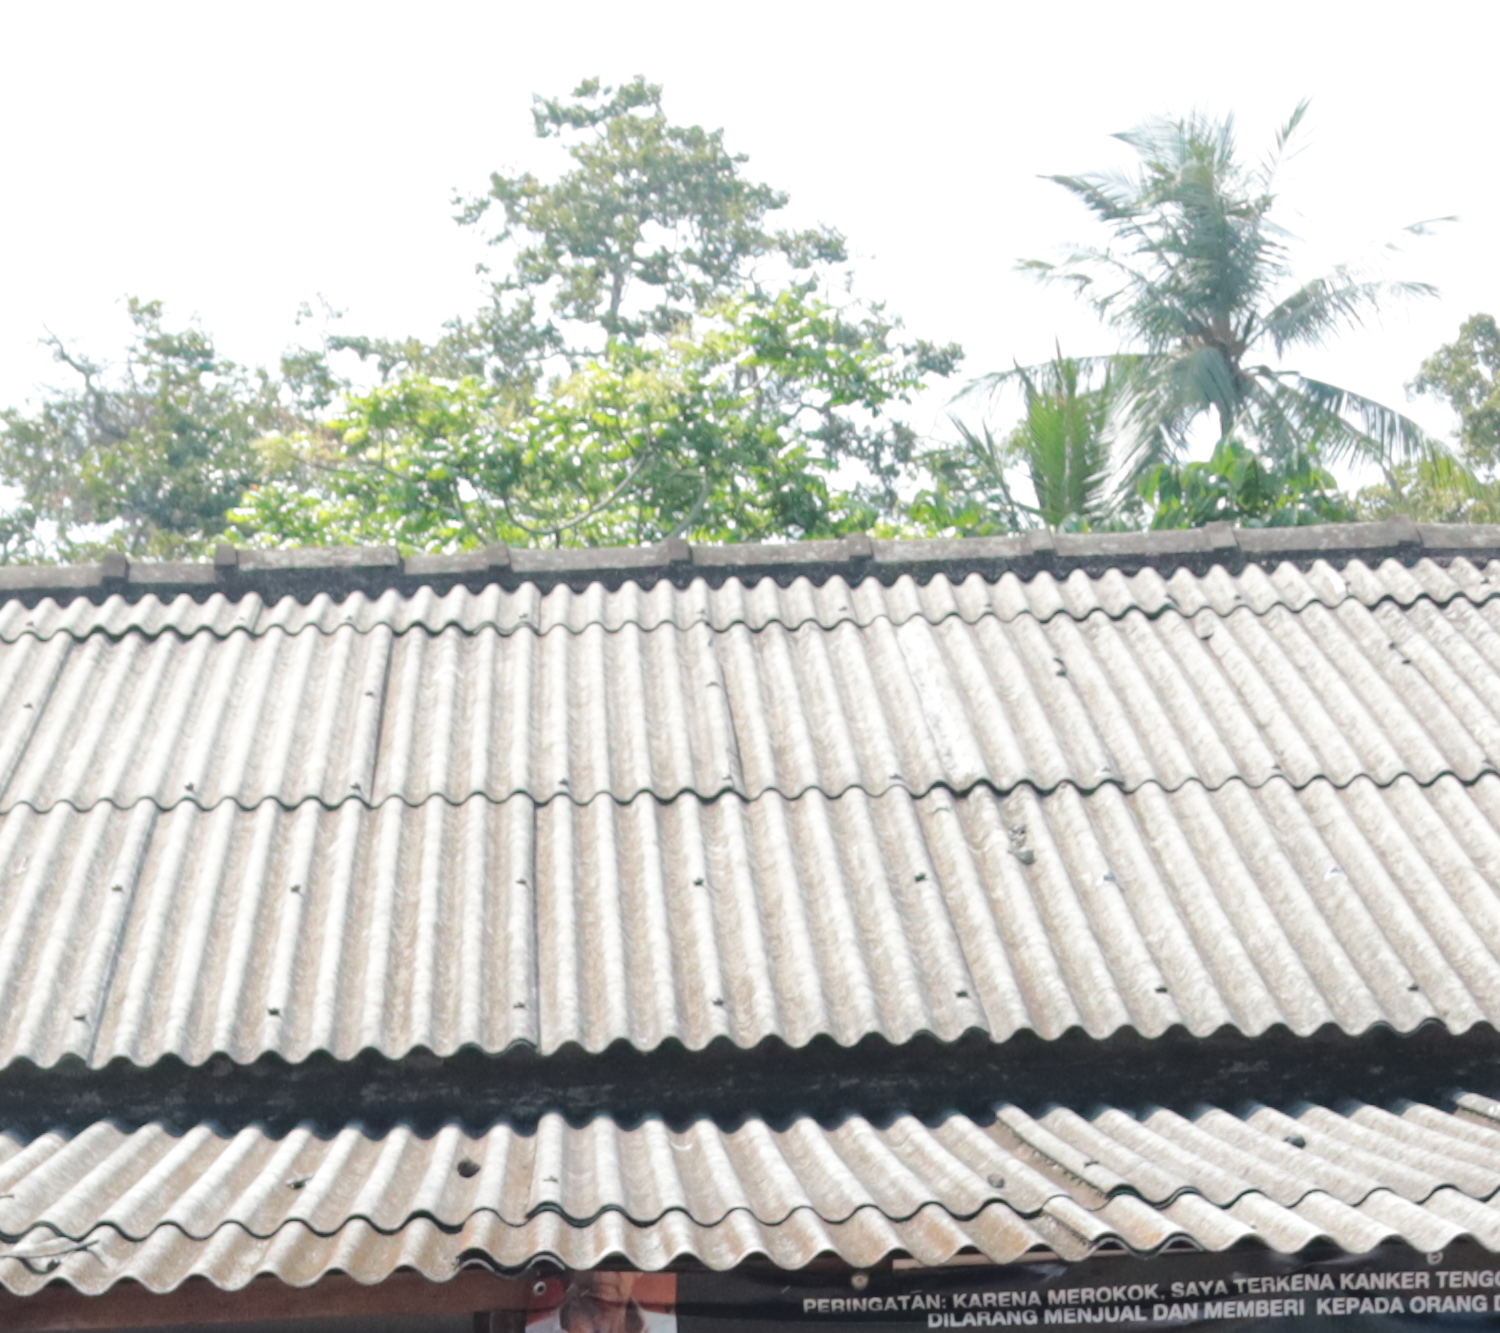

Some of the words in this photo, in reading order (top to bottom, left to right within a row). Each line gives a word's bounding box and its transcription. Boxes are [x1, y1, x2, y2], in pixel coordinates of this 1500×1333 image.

[803, 1292, 946, 1313] PERINGATAN:
[953, 1290, 1041, 1309] KARENA
[1170, 1281, 1229, 1299] SAYA
[1233, 1274, 1335, 1294] TERKENA
[1340, 1270, 1430, 1290] KANKER
[927, 1309, 1039, 1328] DILARANG
[1044, 1305, 1148, 1325] MENJUAL
[1153, 1302, 1199, 1320] DAN
[1203, 1298, 1305, 1319] MEMBERI
[1316, 1296, 1403, 1315] KEPADA
[1409, 1294, 1487, 1314] ORANG
